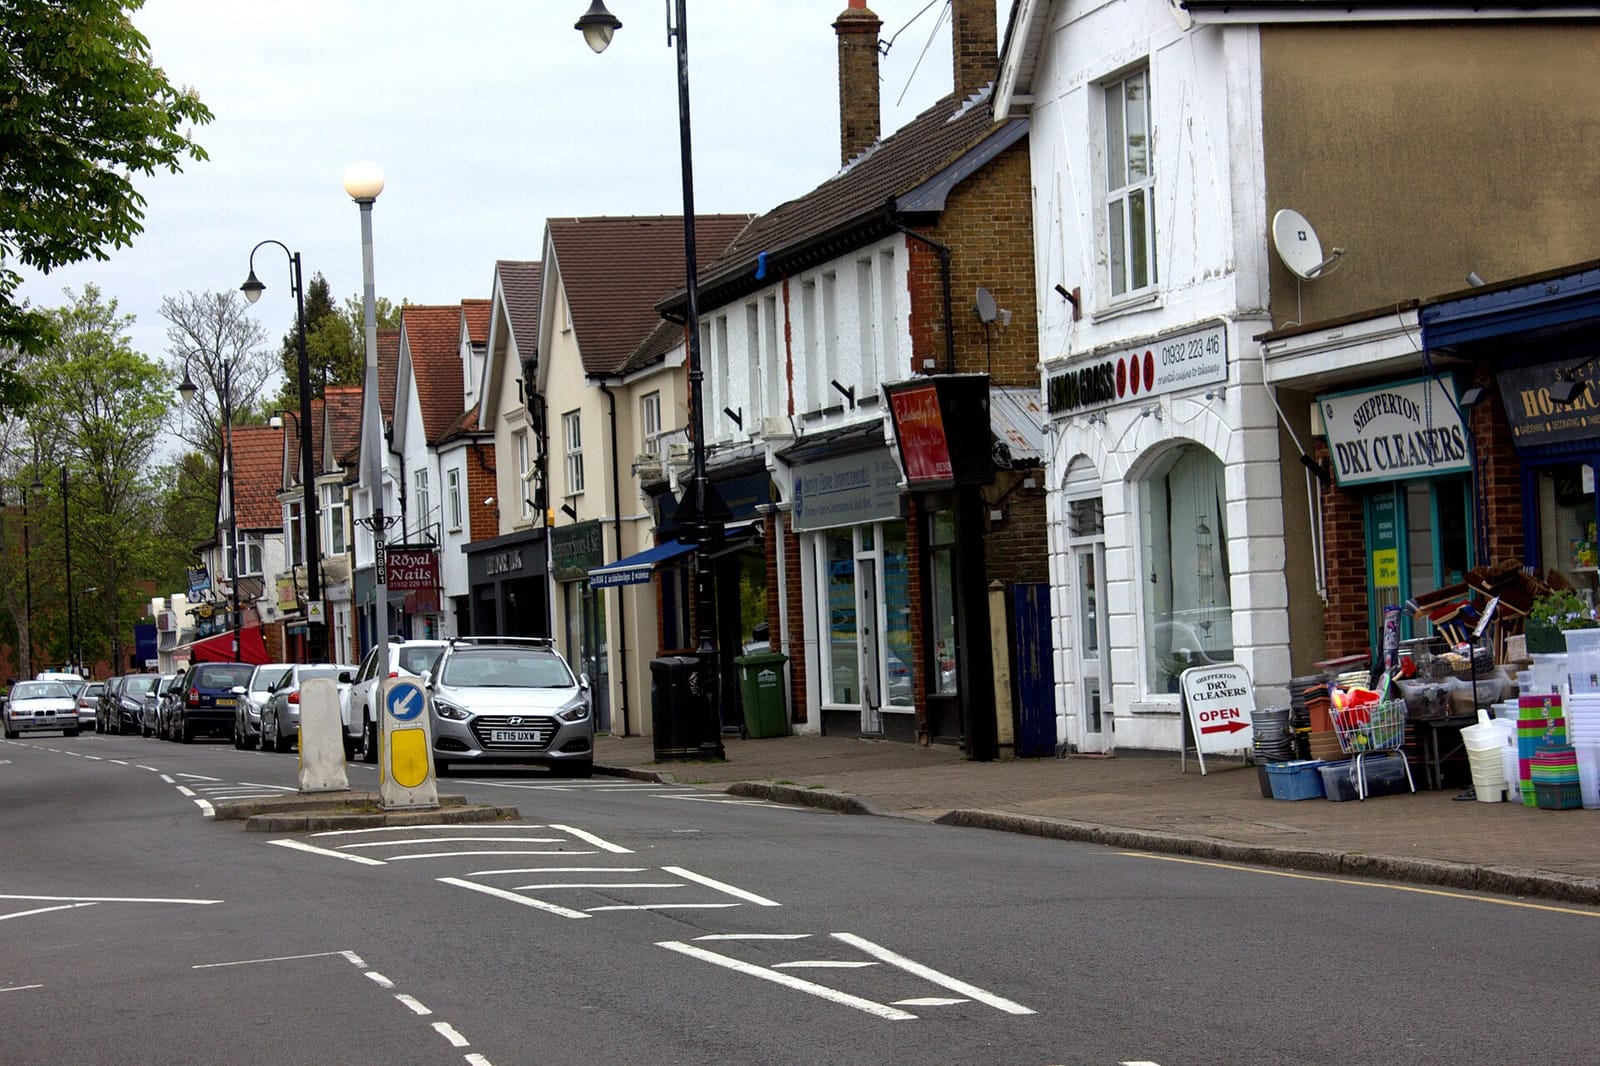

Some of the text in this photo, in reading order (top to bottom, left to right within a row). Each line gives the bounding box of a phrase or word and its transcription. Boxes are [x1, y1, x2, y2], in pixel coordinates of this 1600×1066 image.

[1162, 334, 1220, 366] 01932 223 416
[1047, 361, 1116, 413] LEMON GRASS
[1353, 393, 1421, 434] SHEPPERTON
[1335, 424, 1465, 475] DRY CLEANERS
[389, 553, 431, 568] Royal
[389, 568, 431, 581] Nails
[1196, 673, 1237, 684] SHEPPERTON
[1207, 680, 1228, 691] DRY
[1193, 687, 1247, 702] CLEANERS
[1199, 707, 1240, 722] OPEN
[496, 731, 536, 741] ET15 UXW
